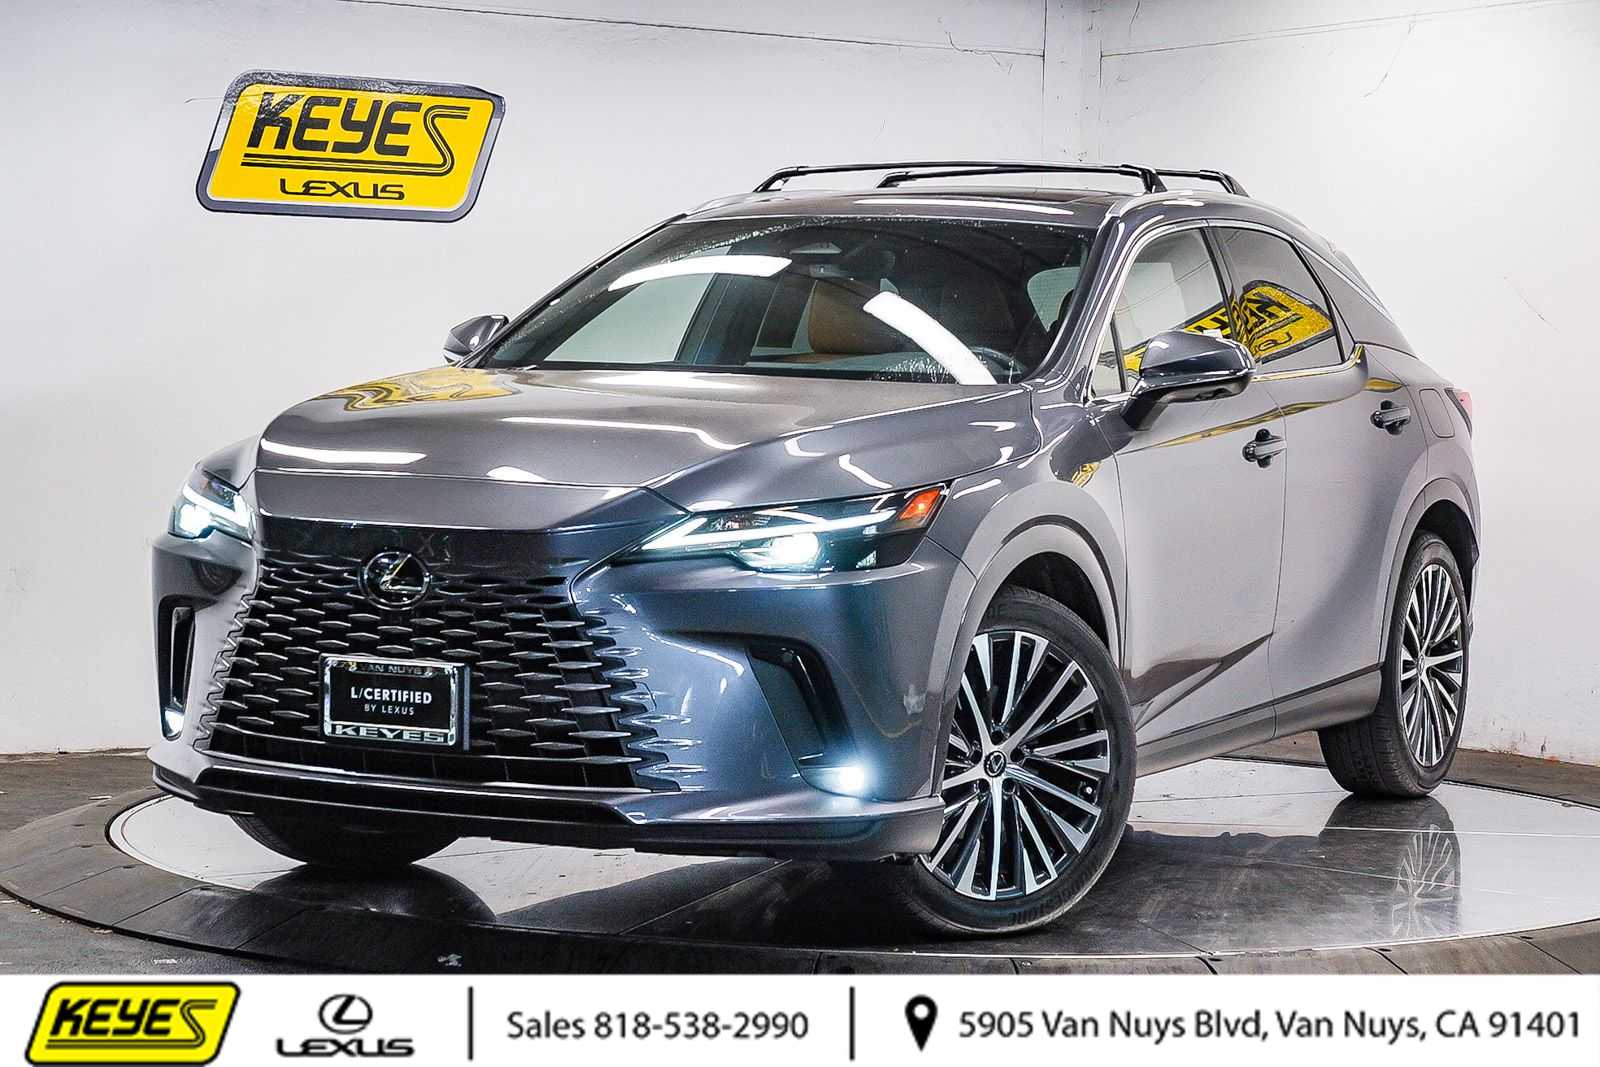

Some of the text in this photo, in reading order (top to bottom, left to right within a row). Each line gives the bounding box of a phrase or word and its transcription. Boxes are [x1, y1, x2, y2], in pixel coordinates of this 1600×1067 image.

[241, 92, 470, 176] KEYES
[280, 178, 404, 201] LEXUS
[350, 686, 433, 705] L/CERTIFIED
[364, 703, 415, 716] BY LEXUS
[335, 724, 445, 743] KEYES
